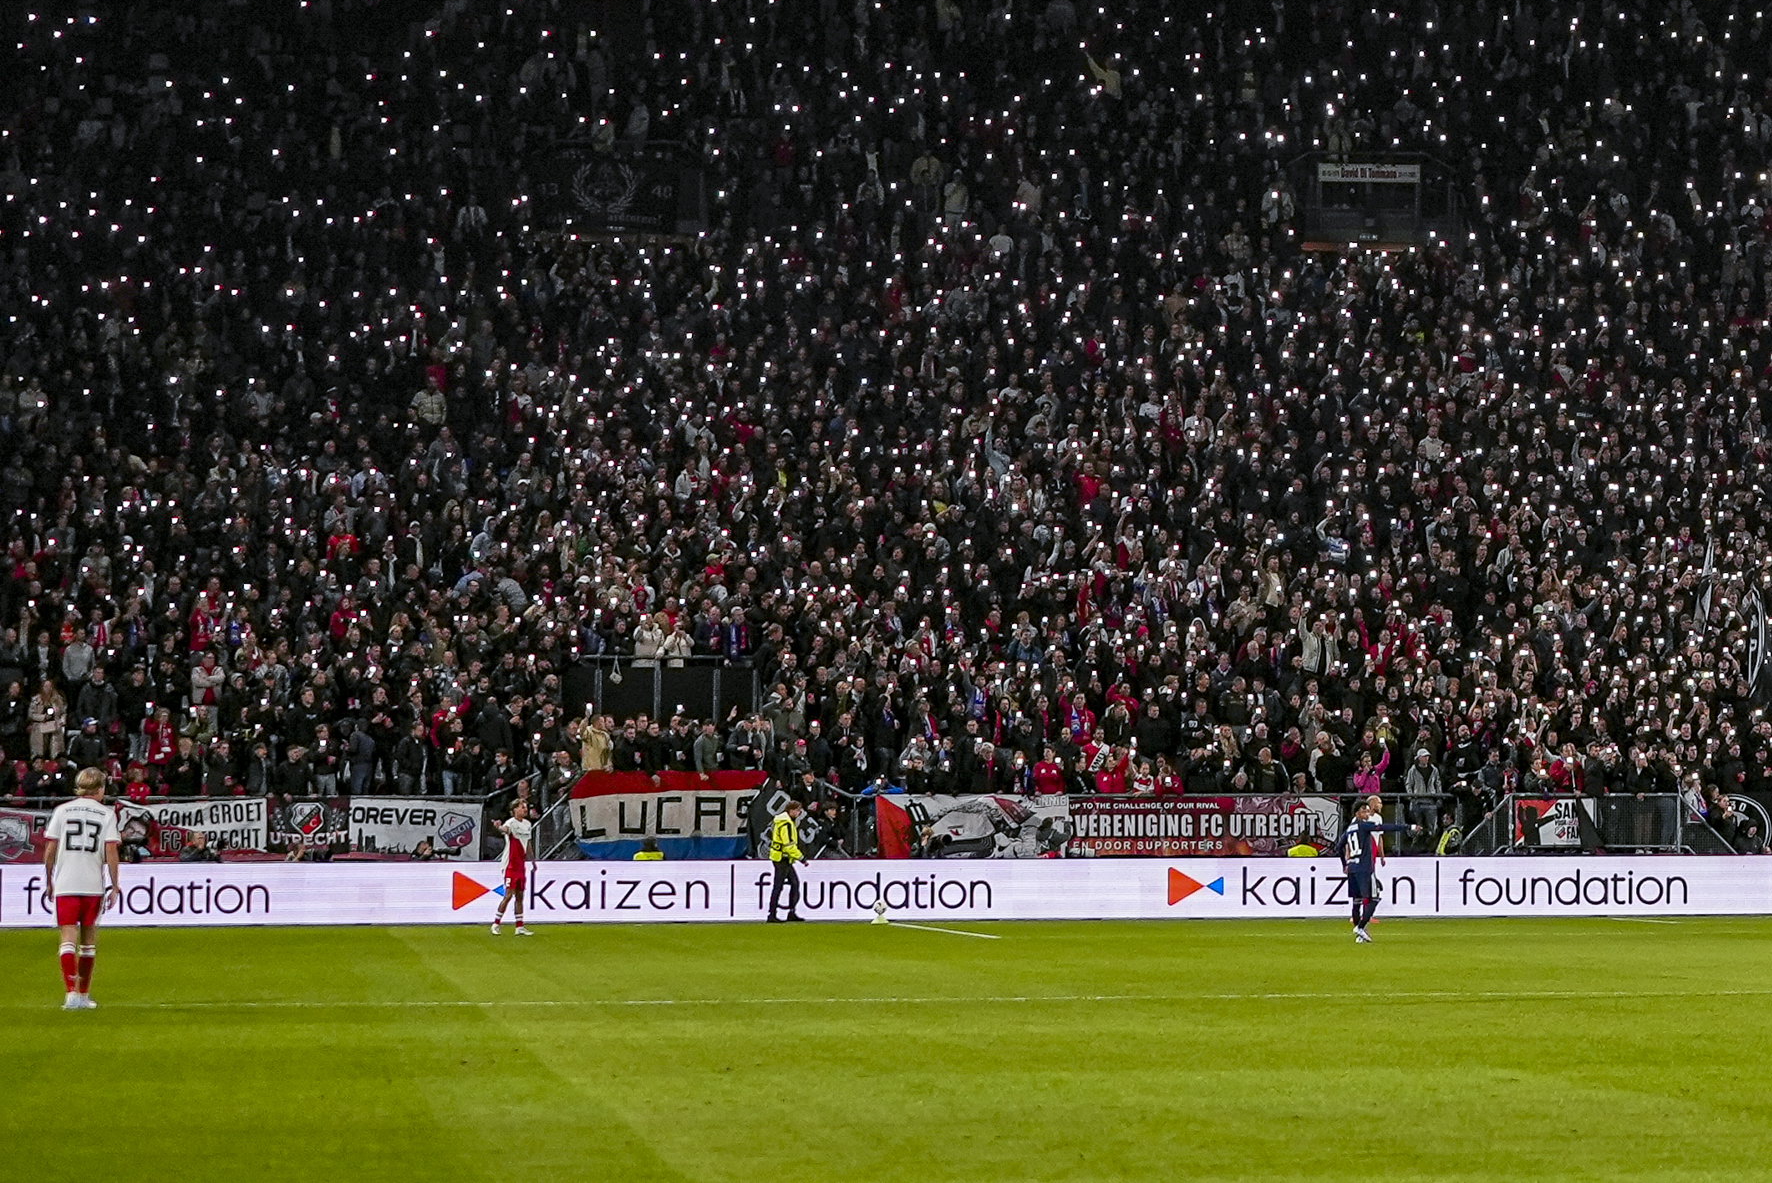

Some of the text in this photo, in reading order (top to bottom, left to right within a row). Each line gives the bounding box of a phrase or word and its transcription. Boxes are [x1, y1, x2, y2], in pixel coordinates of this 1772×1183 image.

[209, 801, 263, 825] GROET
[349, 806, 437, 827] OREVER
[580, 794, 752, 839] LUCAS
[1082, 802, 1094, 810] TO
[1095, 802, 1111, 810] THE
[1113, 802, 1162, 810] CHALLENGE
[1163, 802, 1175, 810] OF
[1177, 802, 1195, 810] OUR
[1198, 802, 1220, 810] RIVAL
[66, 818, 103, 853] 23
[1200, 814, 1223, 837] FC
[1229, 813, 1318, 837] UTRECHT
[160, 830, 182, 852] FC
[269, 829, 348, 846] UTRECHT
[1095, 840, 1132, 851] DOOR
[1137, 840, 1224, 851] SUPPORTERS
[1347, 831, 1362, 855] 11
[530, 868, 709, 910] kaizen
[1241, 866, 1689, 908] kaizn foundation
